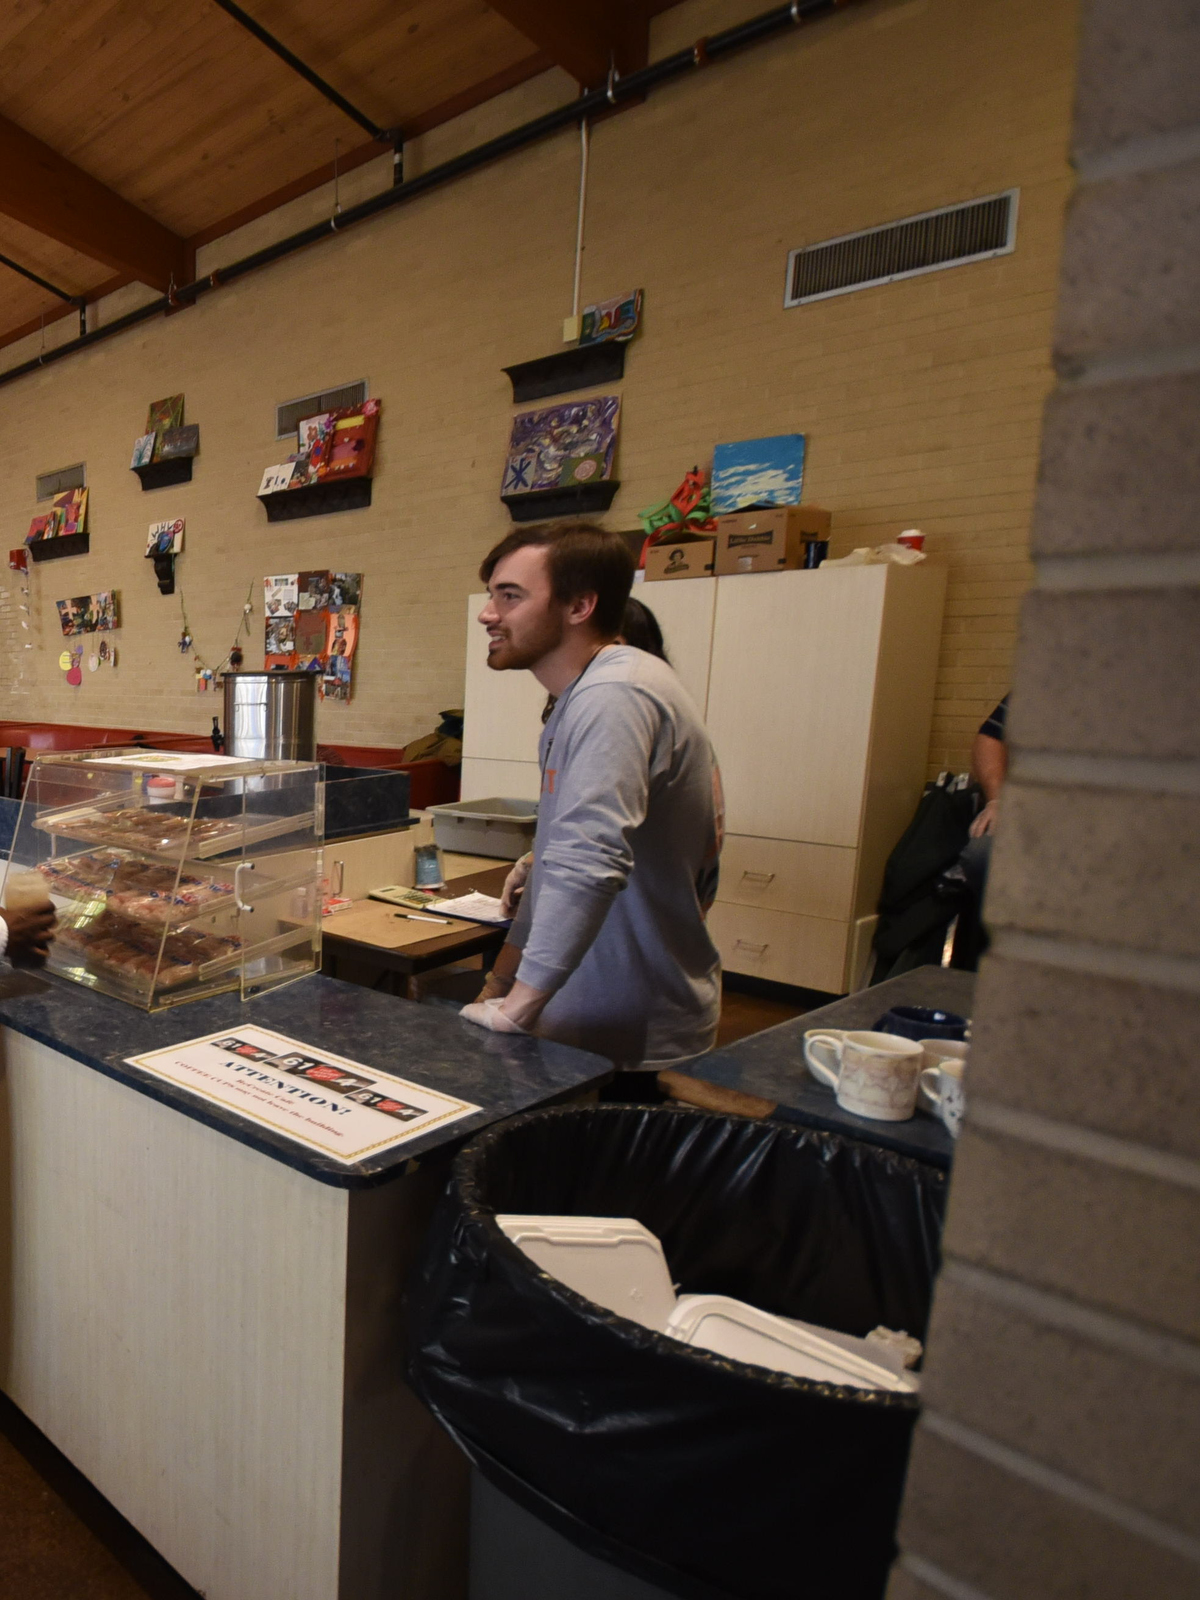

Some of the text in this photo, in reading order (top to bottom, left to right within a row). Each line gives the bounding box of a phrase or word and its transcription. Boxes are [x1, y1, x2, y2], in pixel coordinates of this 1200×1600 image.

[283, 1057, 315, 1070] 61
[219, 1061, 352, 1115] ATTENTION!
[358, 1092, 382, 1103] 61
[267, 1100, 289, 1111] leave
[289, 1110, 304, 1118] the
